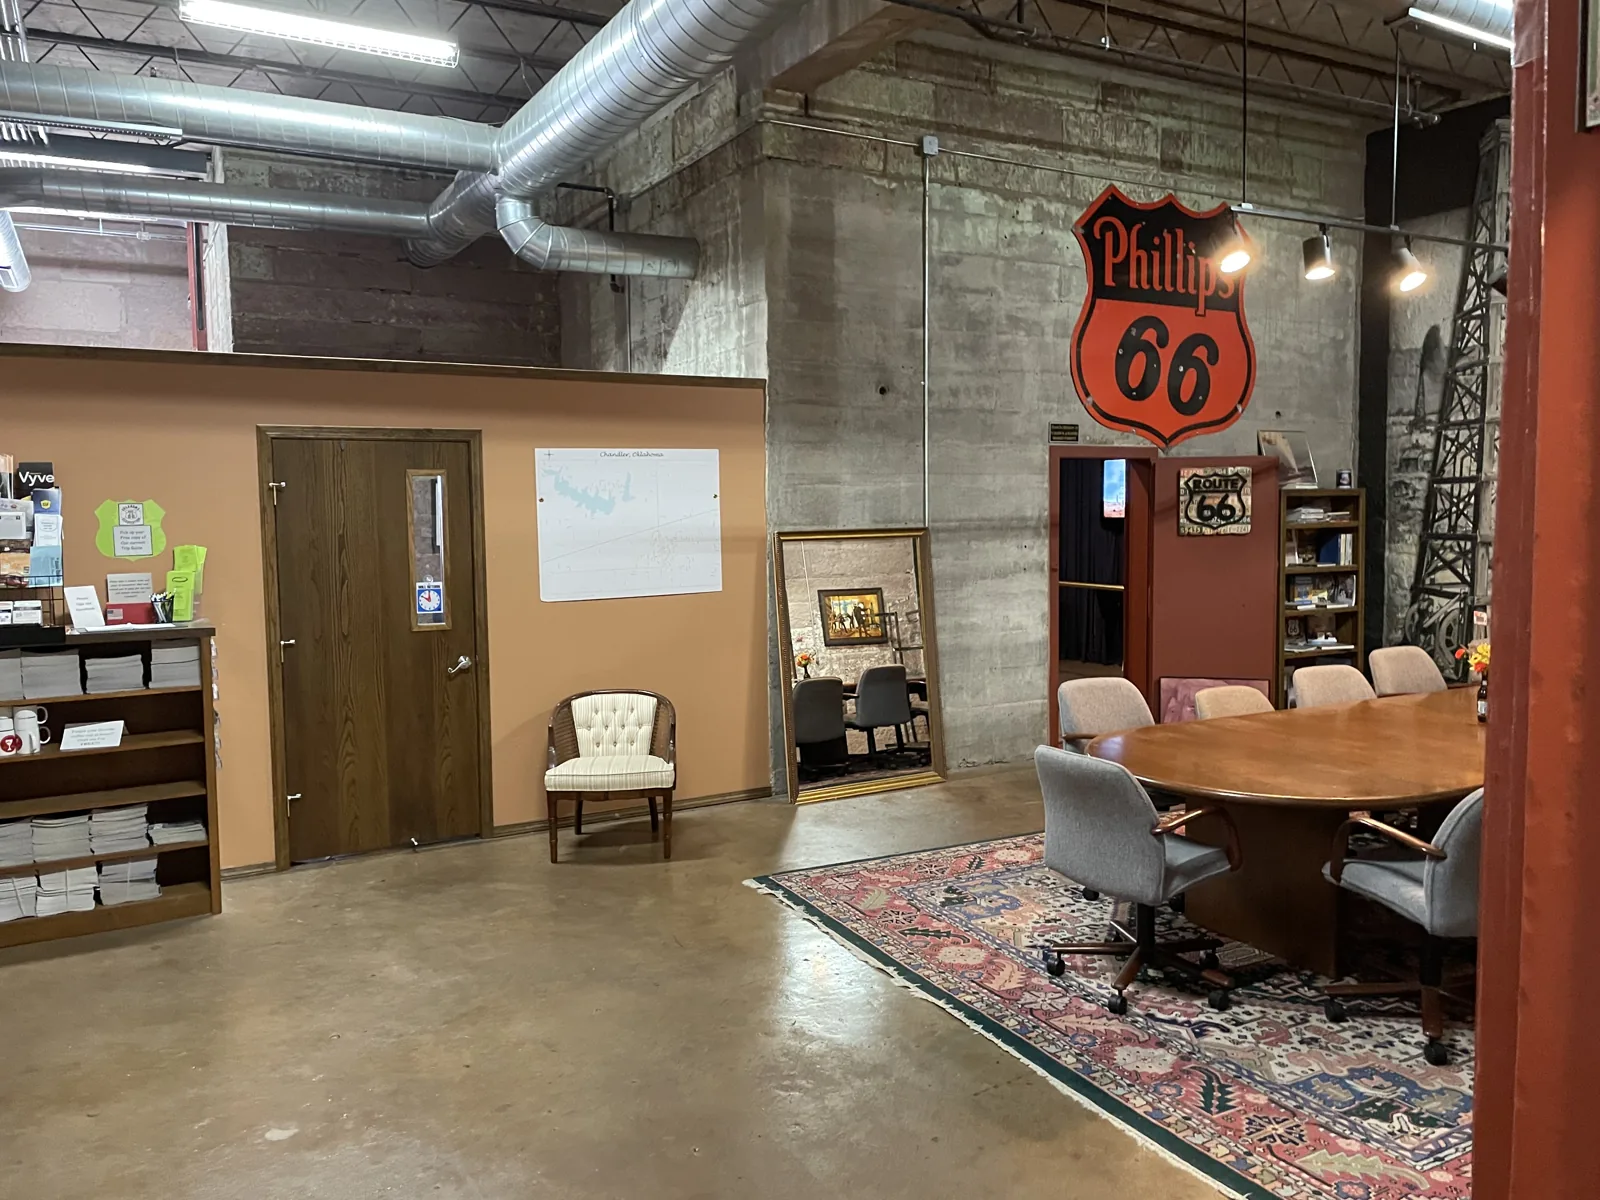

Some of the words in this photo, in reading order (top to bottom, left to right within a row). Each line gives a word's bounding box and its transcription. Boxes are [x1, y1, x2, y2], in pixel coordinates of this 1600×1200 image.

[1093, 215, 1236, 317] Phillips
[1114, 315, 1220, 417] 66
[18, 471, 55, 487] Vyve
[1192, 478, 1239, 490] ROUTE
[1196, 493, 1236, 522] 66
